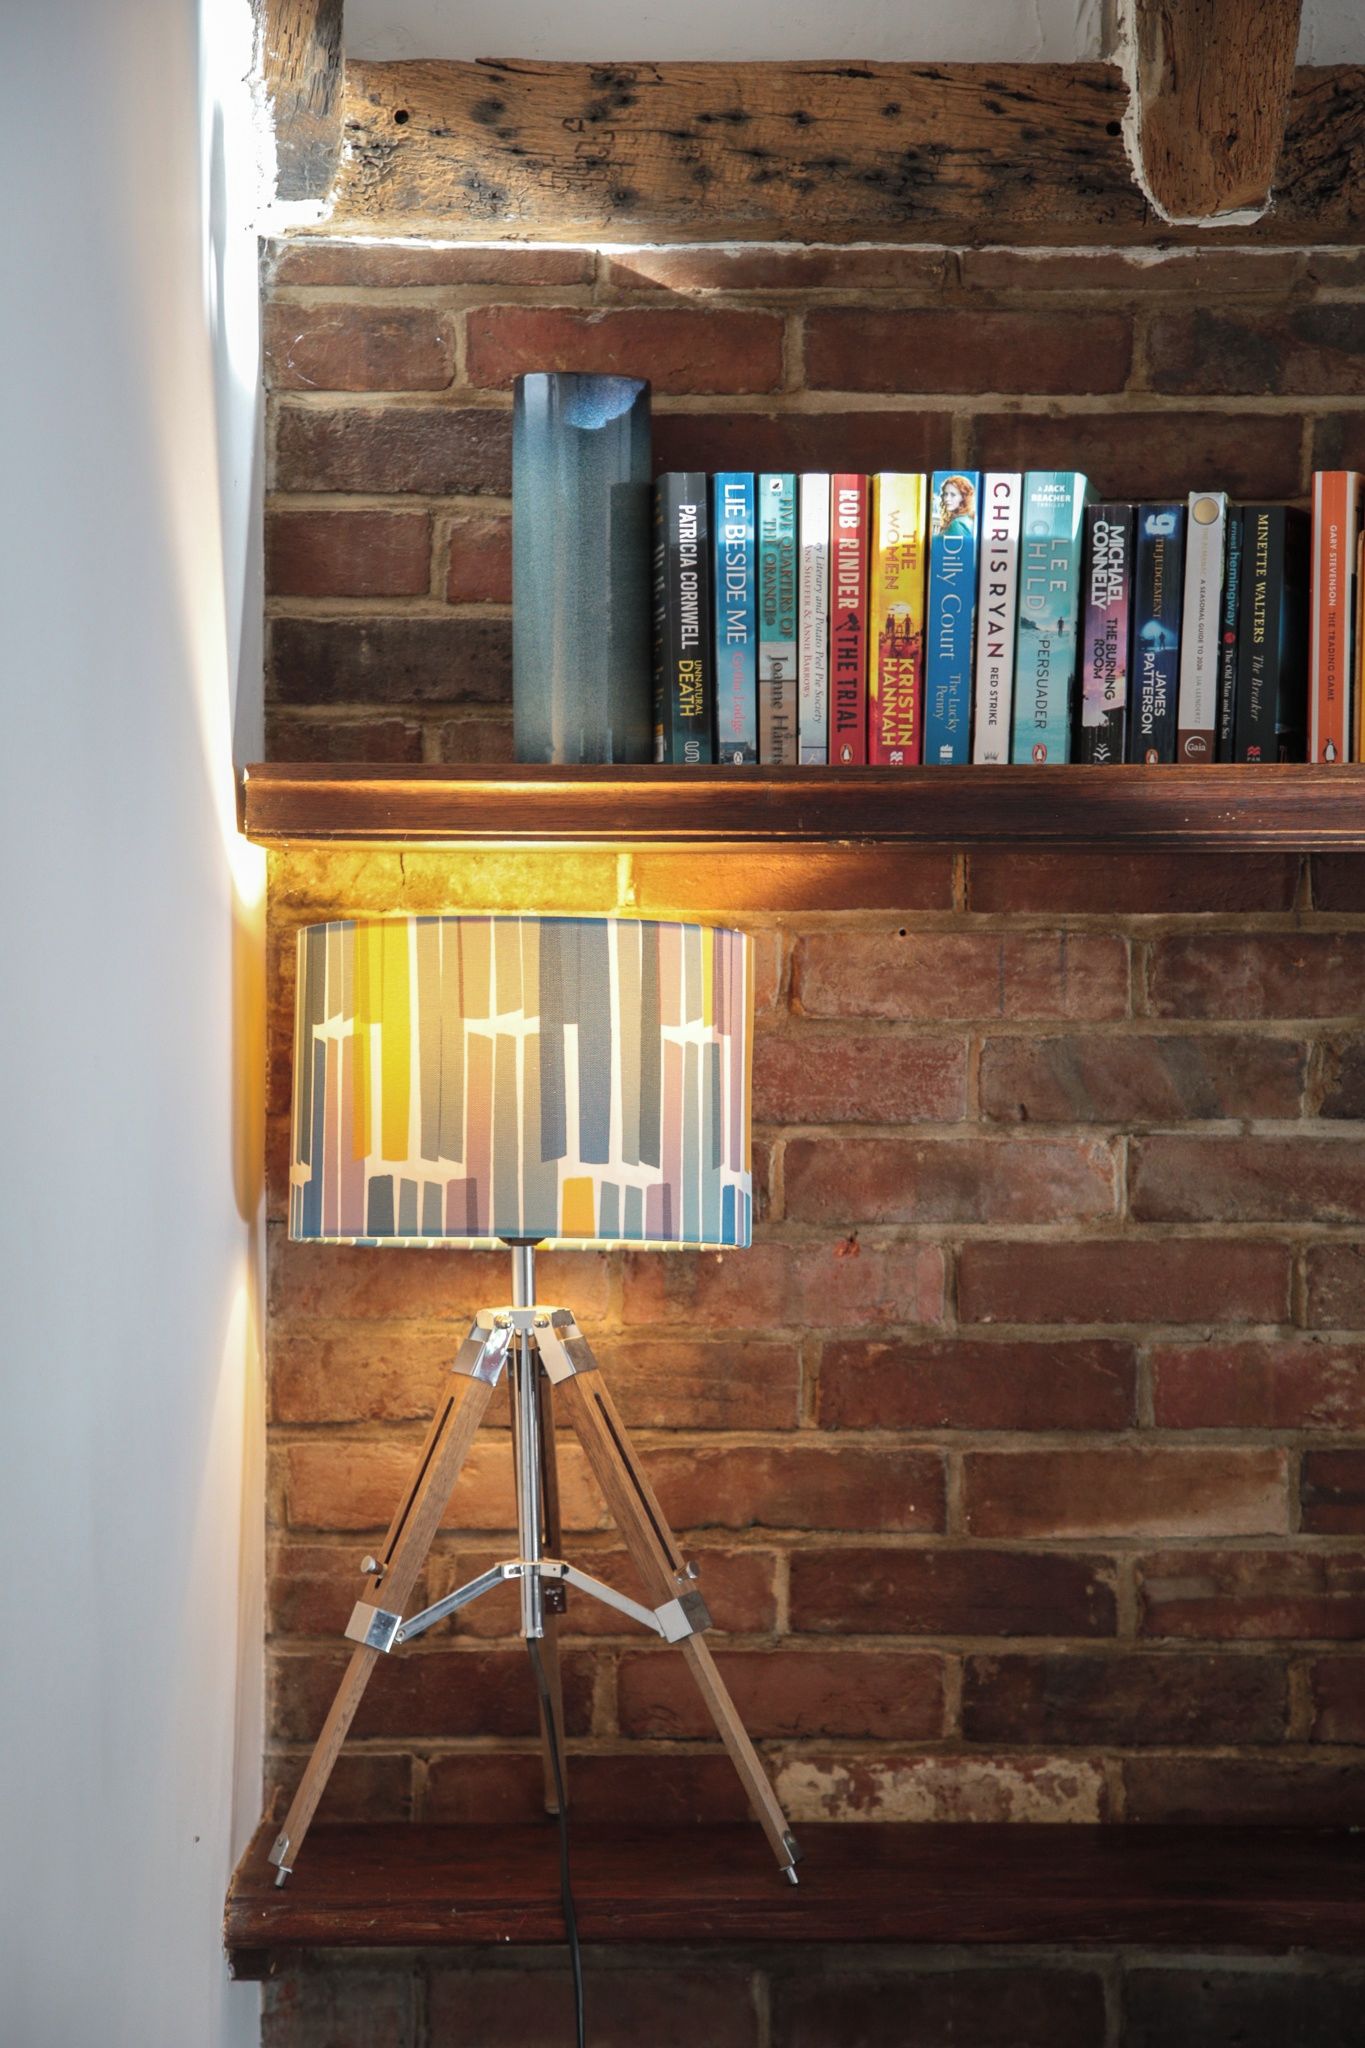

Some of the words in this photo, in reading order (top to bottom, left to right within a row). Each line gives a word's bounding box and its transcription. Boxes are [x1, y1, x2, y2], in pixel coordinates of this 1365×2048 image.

[725, 484, 746, 518] LIE
[1031, 494, 1071, 502] REACHER
[1043, 484, 1065, 492] JACK
[779, 499, 792, 530] FIVE
[838, 489, 859, 529] ROB
[990, 482, 1011, 573] CHRIS
[679, 505, 697, 567] PATRICIA
[763, 518, 777, 546] THE
[885, 510, 900, 590] WOMEN
[901, 530, 916, 570] THE
[1256, 514, 1269, 577] MINETTE
[1329, 525, 1338, 550] GARY
[725, 524, 747, 602] BESIDE
[778, 536, 792, 613] QUARTERS
[815, 556, 825, 594] Literary
[838, 538, 859, 609] RINDER
[937, 535, 963, 586] Dilly
[1026, 520, 1050, 610] CHILD
[1050, 537, 1068, 592] LEE
[1091, 520, 1109, 611] CONNELLY
[1107, 525, 1125, 605] MICHAEL
[1328, 553, 1337, 606] STEVENSON
[763, 553, 777, 618] ORANGE
[816, 596, 825, 614] and
[1152, 553, 1164, 617] JUDGEMENT
[1225, 552, 1240, 626] hemingway
[681, 572, 699, 650] CORNWELL
[727, 610, 747, 645] ME
[781, 616, 793, 638] OF
[939, 594, 962, 660] Court
[987, 583, 1007, 658] RYAN
[1106, 617, 1118, 641] THE
[1254, 582, 1266, 643] WALTERS
[1328, 612, 1336, 628] THE
[815, 618, 825, 654] Potato
[837, 635, 857, 672] THE
[1197, 645, 1204, 655] TO
[1225, 649, 1234, 663] The
[1327, 631, 1336, 671] TRADING
[803, 655, 812, 698] BARROWS
[815, 656, 825, 671] Peel
[990, 667, 999, 688] RED
[1093, 639, 1105, 679] ROOM
[1104, 642, 1117, 700] BURNING
[1224, 665, 1233, 679] Old
[1252, 655, 1264, 674] The
[679, 660, 694, 716] DEATH
[694, 660, 703, 715] UNNATURAL
[767, 655, 788, 709] Joanne
[815, 673, 825, 688] Pie
[949, 673, 961, 695] The
[1034, 638, 1050, 729] PERSUADER
[1141, 652, 1155, 734] PATTERSON
[1154, 671, 1166, 716] JAMES
[1224, 681, 1232, 697] Man
[1250, 678, 1263, 721] Breaker
[1327, 674, 1336, 701] GAME
[731, 696, 746, 733] Lodge
[812, 691, 824, 724] Society
[836, 678, 857, 733] TRIAL
[881, 657, 897, 746] HANNAH
[897, 658, 914, 745] KRISTIN
[932, 685, 948, 720] Penny
[946, 698, 960, 733] Lucky
[988, 690, 998, 726] STRIKE
[1222, 714, 1231, 726] the
[1223, 698, 1231, 712] and
[771, 715, 788, 764] Harris
[1187, 743, 1206, 752] Gaia
[1222, 727, 1230, 739] Sea
